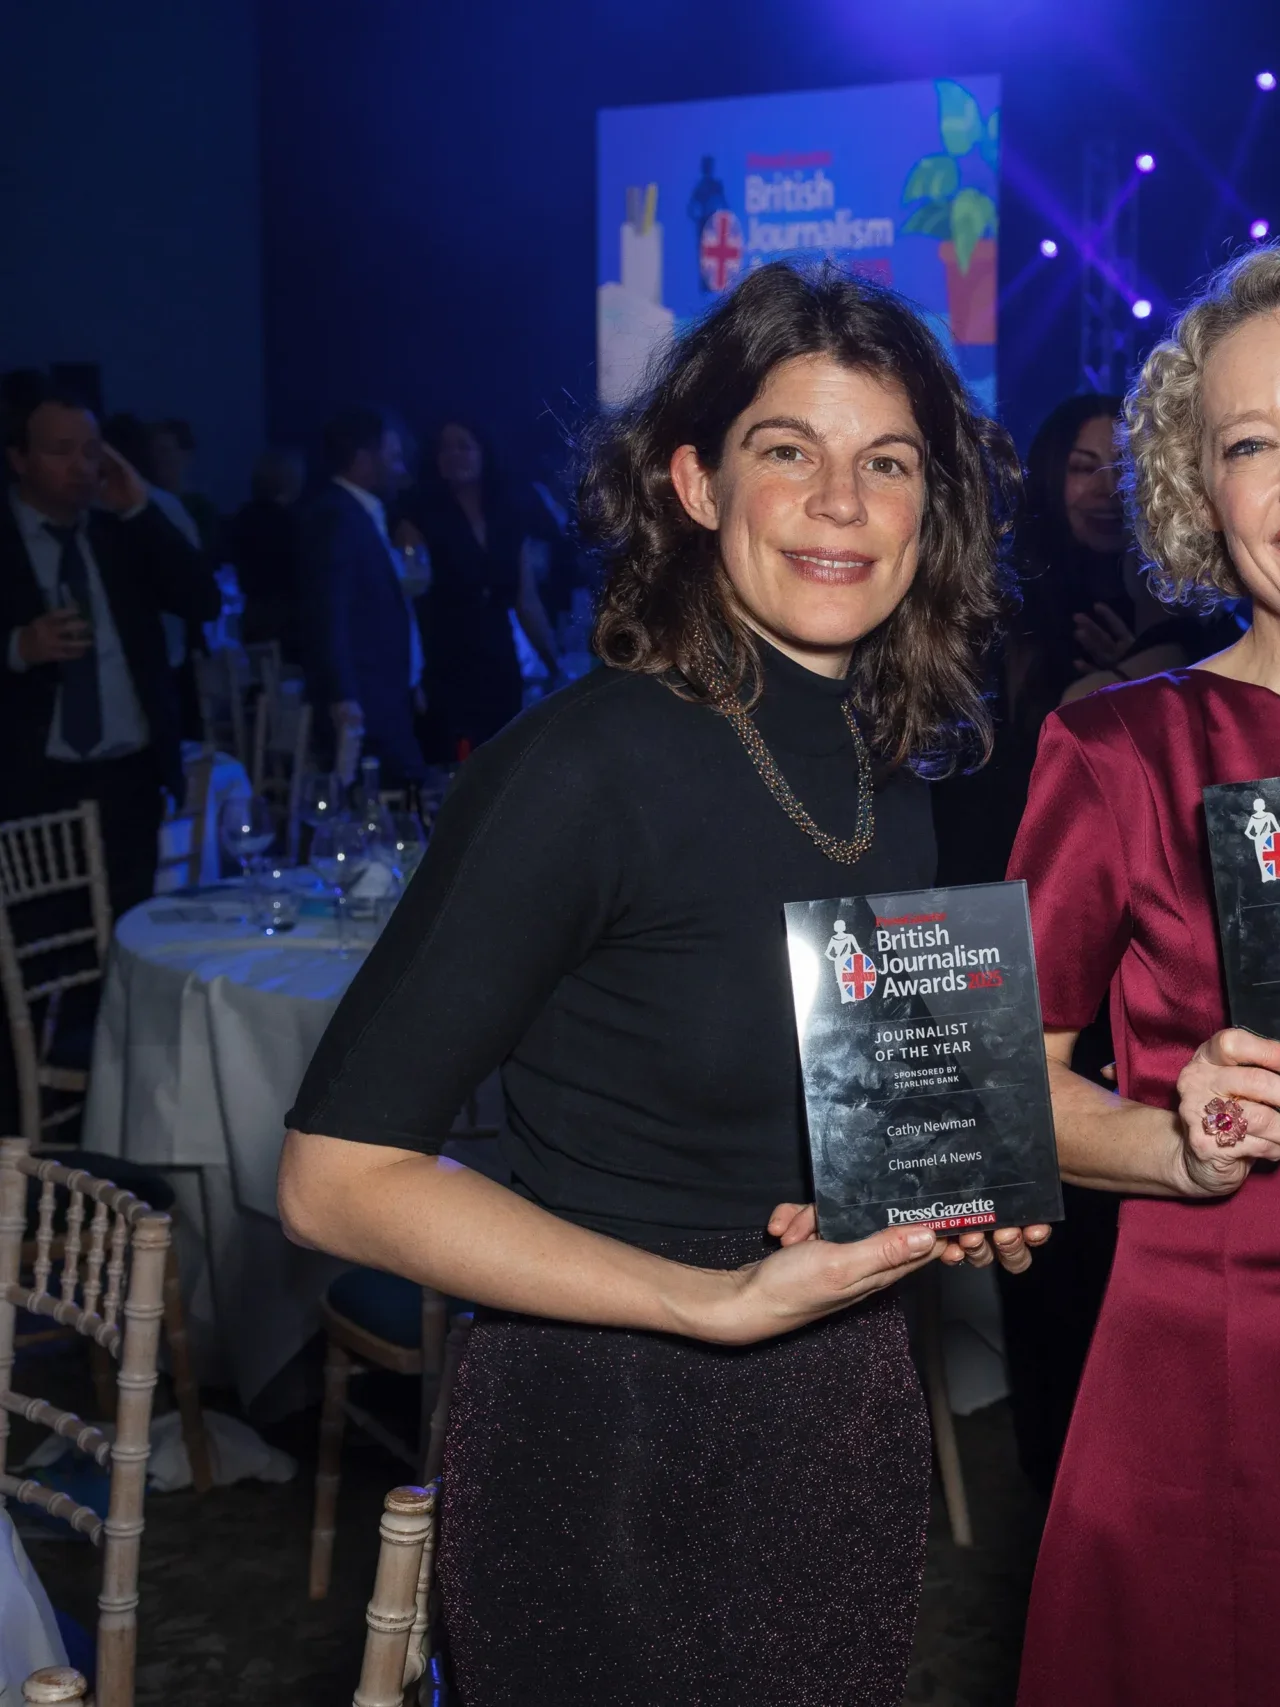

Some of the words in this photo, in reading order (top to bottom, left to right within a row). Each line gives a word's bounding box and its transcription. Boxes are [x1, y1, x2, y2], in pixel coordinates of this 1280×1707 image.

[876, 924, 950, 952] British
[877, 944, 1000, 975] Journalism
[874, 1023, 968, 1044] JOURNALIST
[875, 1049, 894, 1062] OF
[900, 1045, 929, 1059] THE
[933, 1041, 972, 1055] YEAR
[894, 1067, 944, 1080] SPONSORED
[946, 1066, 957, 1074] BY
[894, 1078, 935, 1089] STARLING
[937, 1075, 960, 1085] BANK
[887, 1123, 921, 1137] Cathy
[924, 1118, 976, 1132] Newman
[888, 1154, 937, 1171] Channel
[940, 1154, 947, 1164] 4
[949, 1151, 982, 1163] News
[886, 1198, 995, 1224] PressGazette
[950, 1219, 961, 1227] OF
[964, 1215, 995, 1225] MEDIA
